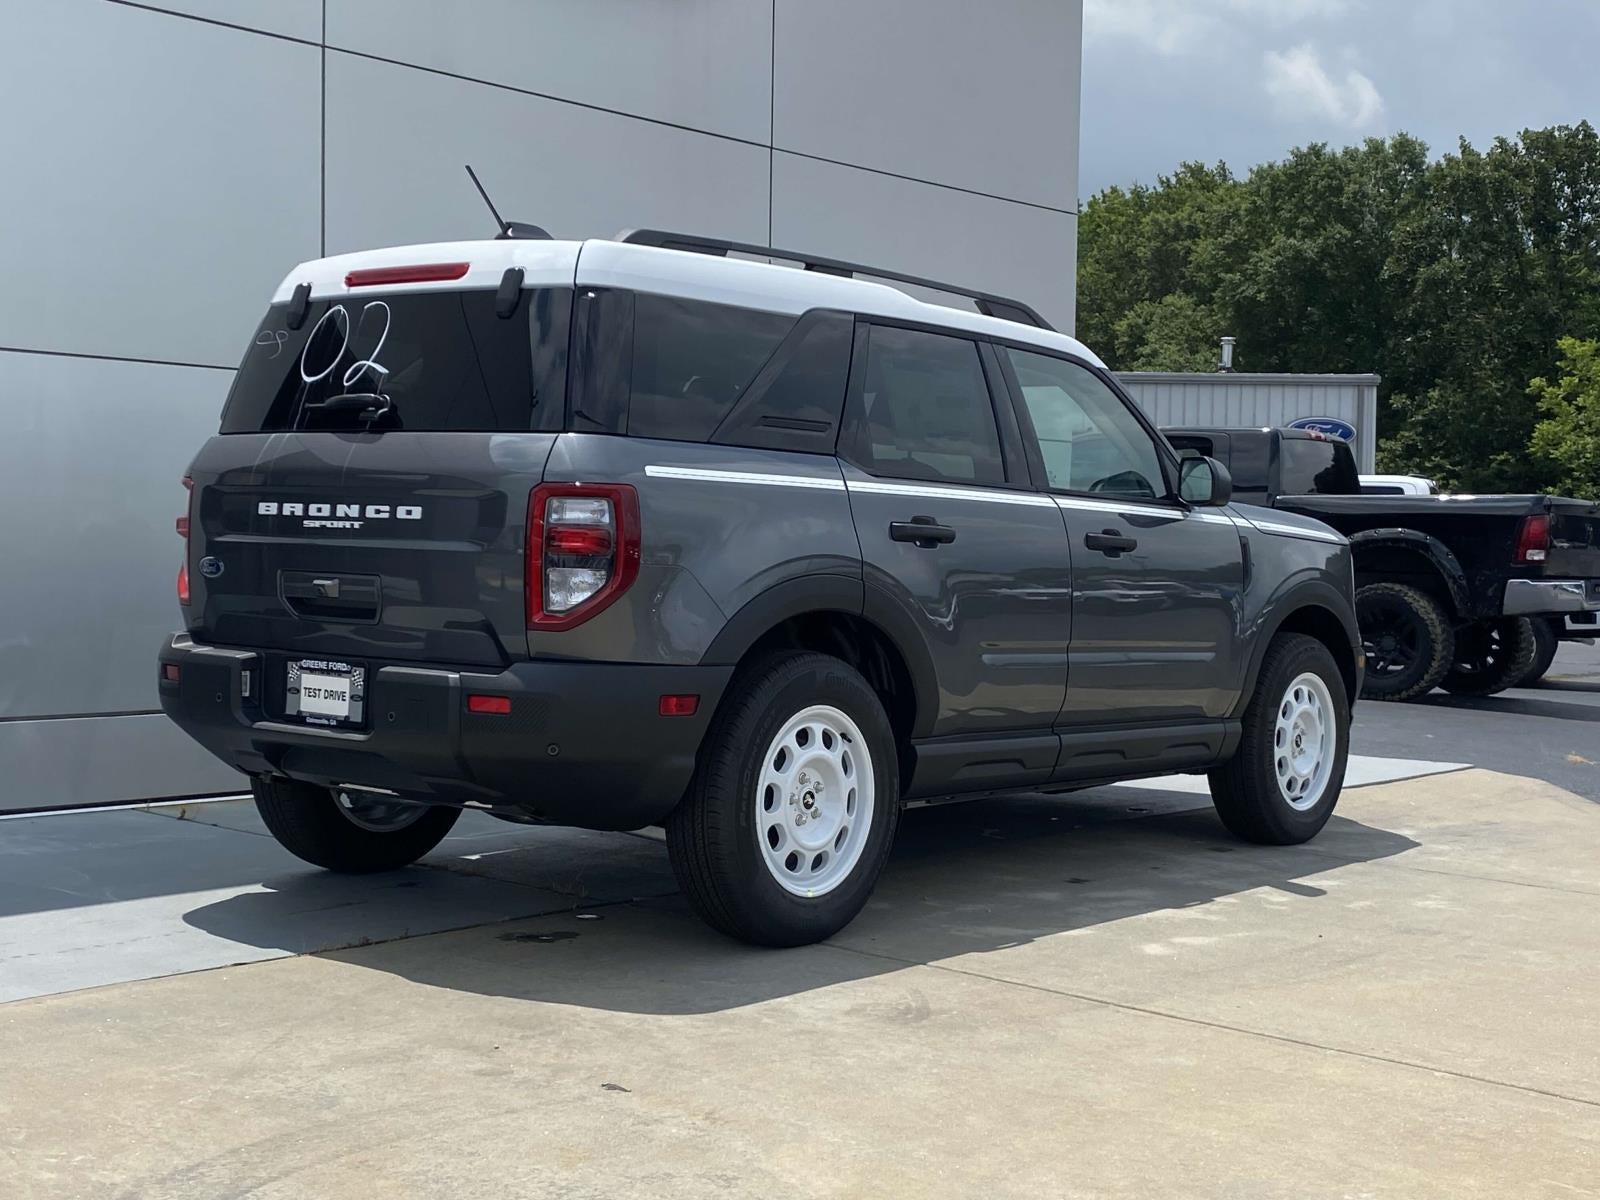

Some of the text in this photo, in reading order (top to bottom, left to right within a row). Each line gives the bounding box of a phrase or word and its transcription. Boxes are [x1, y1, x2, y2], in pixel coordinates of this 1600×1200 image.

[258, 502, 423, 519] BRONCO
[302, 520, 364, 528] SPORT
[301, 659, 348, 671] GREENE FORD
[303, 687, 322, 699] TEST
[323, 689, 347, 702] DRIVE
